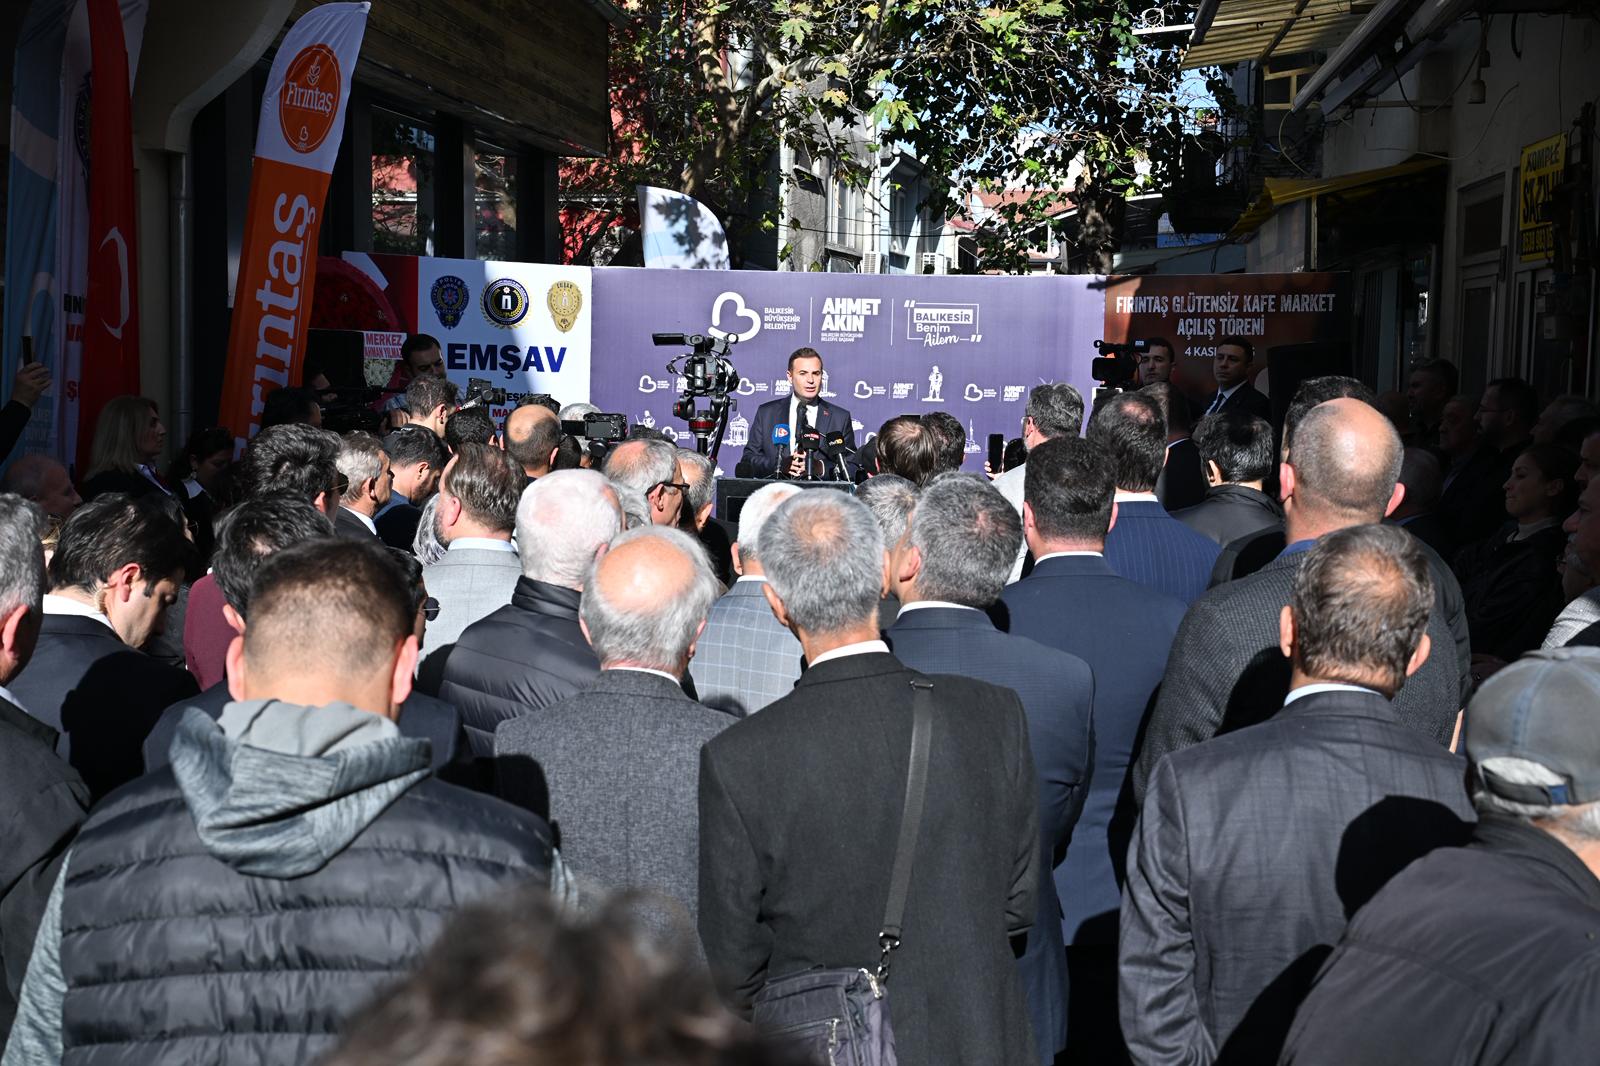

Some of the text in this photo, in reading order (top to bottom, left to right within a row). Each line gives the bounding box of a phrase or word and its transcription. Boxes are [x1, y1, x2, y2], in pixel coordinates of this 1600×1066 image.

[764, 306, 794, 314] BALIKESİR
[822, 298, 881, 315] AHMET
[1116, 292, 1336, 318] FIRINTAŞ GLÜTENSİZ KAFE MARKET
[764, 315, 801, 323] BÜYÜKŞEHİR
[915, 311, 971, 322] BALIKESİR
[764, 322, 797, 330] BELEDİYESİ
[821, 315, 865, 332] AKIN
[916, 323, 950, 333] Benim
[1177, 314, 1265, 340] AÇILIŞ TÖRENİ
[366, 333, 402, 346] MERKEZ
[923, 332, 960, 348] Ailem
[1185, 346, 1217, 357] 4 KASI
[447, 343, 567, 379] EMŞAV
